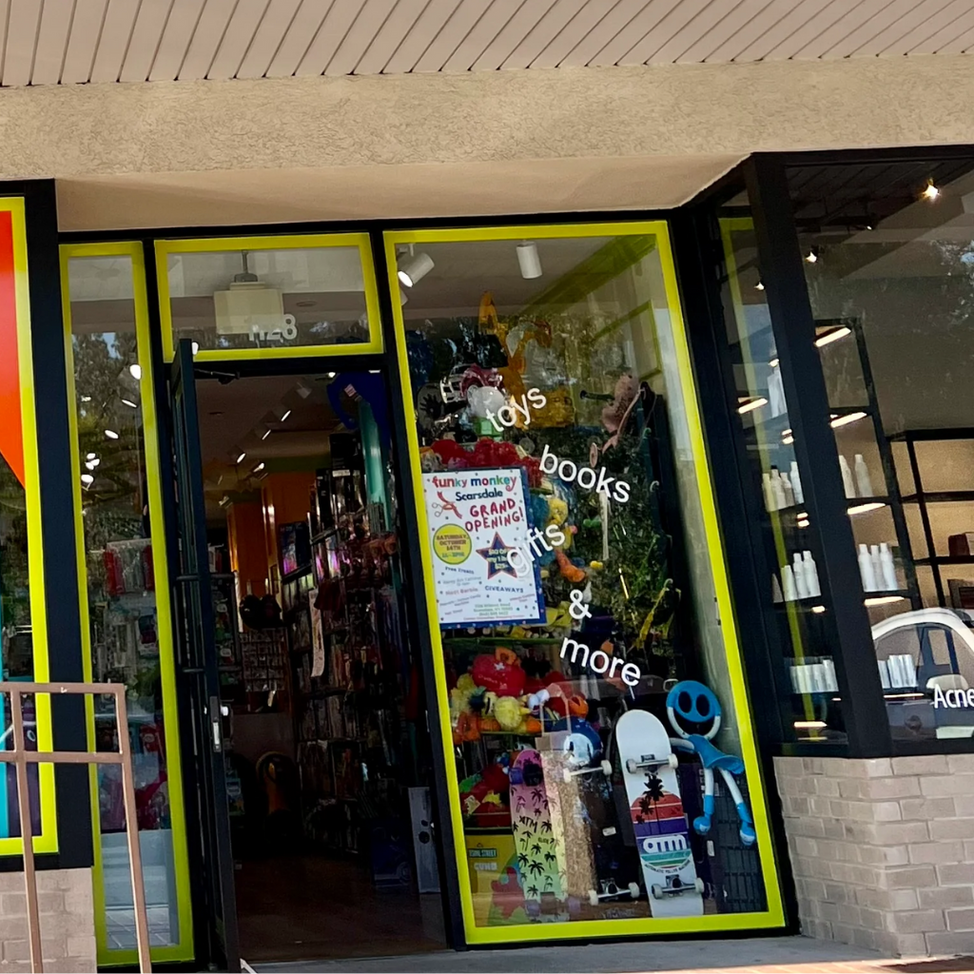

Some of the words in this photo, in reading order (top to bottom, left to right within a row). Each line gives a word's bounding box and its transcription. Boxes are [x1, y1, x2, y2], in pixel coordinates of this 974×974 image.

[485, 387, 547, 432] toys
[432, 476, 467, 488] funky
[471, 475, 517, 492] monkey
[539, 444, 630, 503] books
[455, 487, 504, 502] Scarsdale
[469, 498, 516, 517] GRAND
[464, 506, 525, 533] OPENING!
[506, 523, 566, 577] gifts
[484, 585, 524, 594] GIVEAWAYS
[568, 589, 593, 620] &
[560, 636, 641, 687] more
[934, 683, 974, 709] Acne
